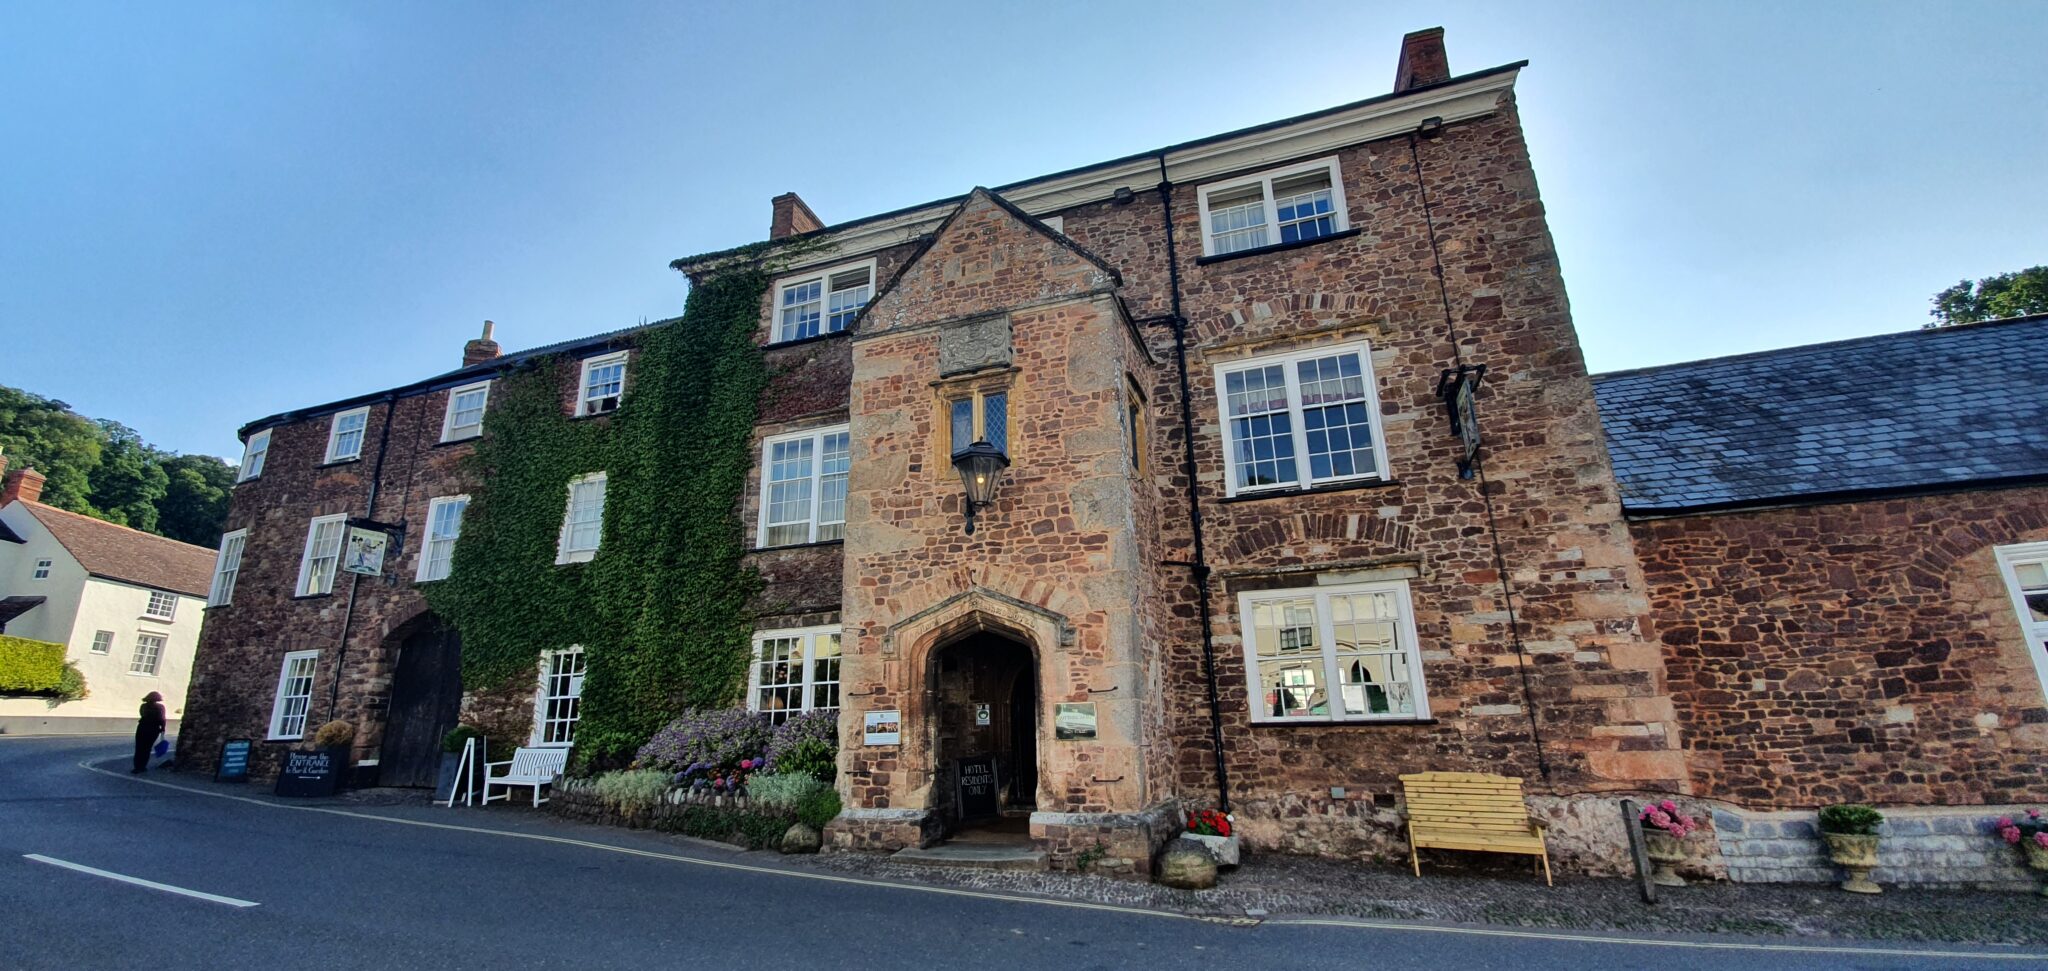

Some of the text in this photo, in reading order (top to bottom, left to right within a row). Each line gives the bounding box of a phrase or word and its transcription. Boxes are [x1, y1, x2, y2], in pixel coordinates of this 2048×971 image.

[290, 759, 329, 767] ENTRANCE
[965, 764, 989, 775] HOTEL
[968, 785, 987, 796] ONLY
